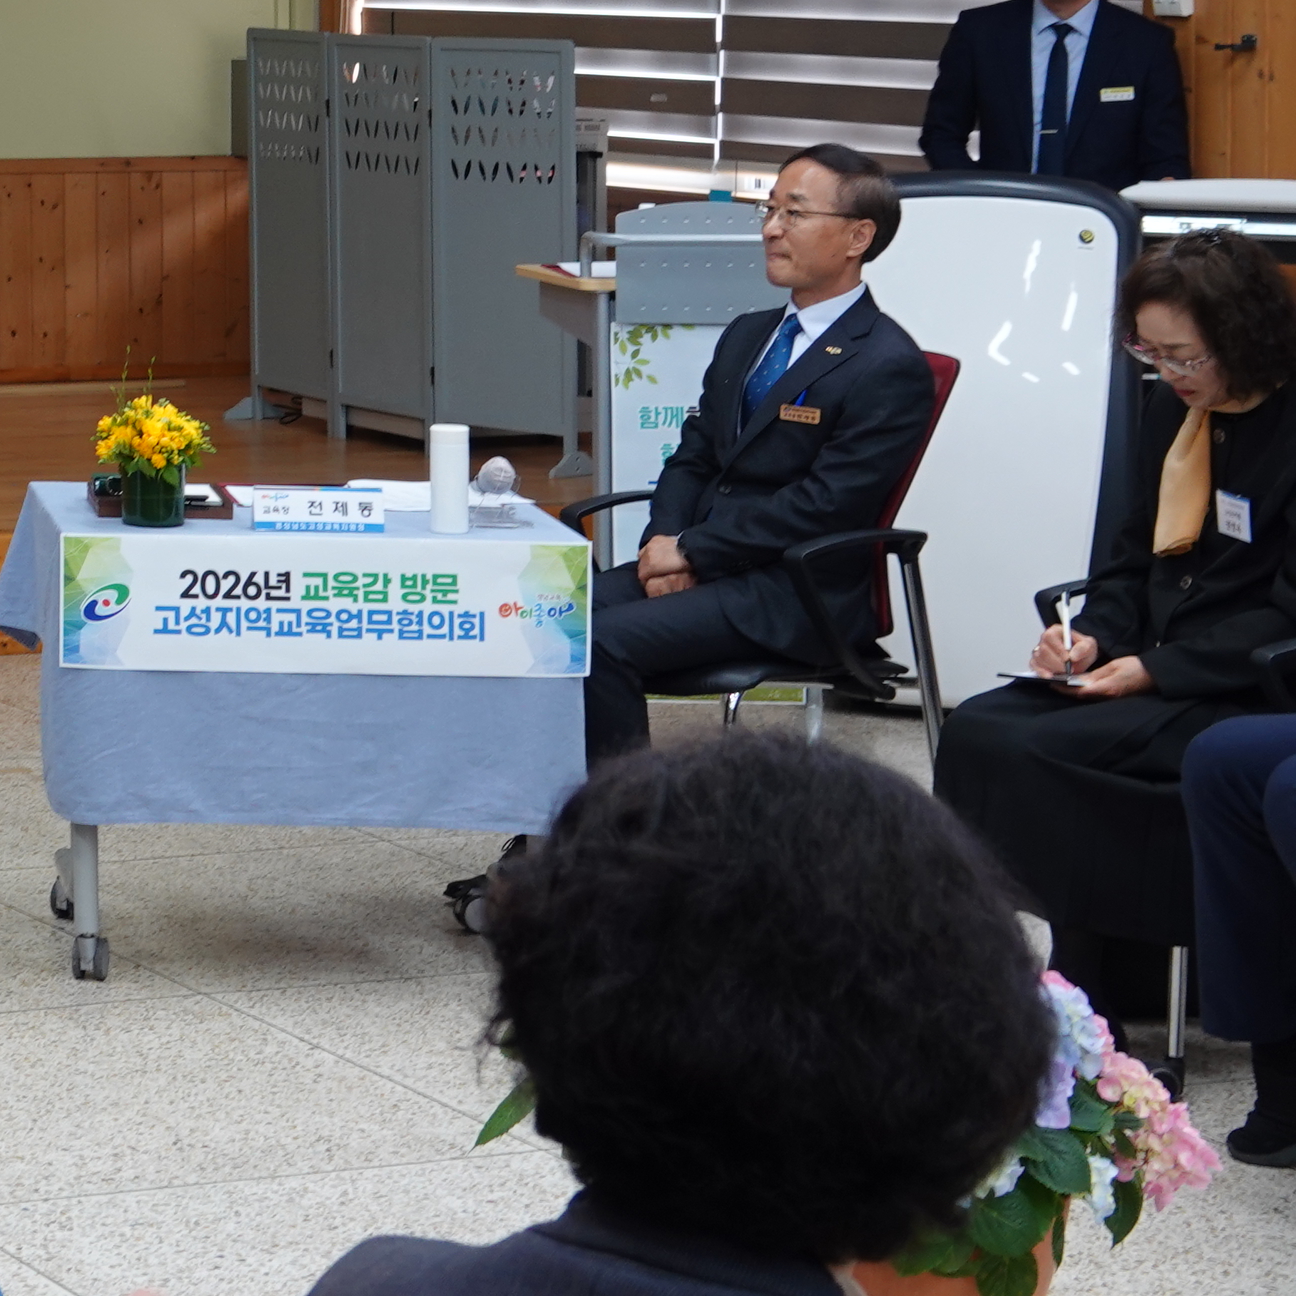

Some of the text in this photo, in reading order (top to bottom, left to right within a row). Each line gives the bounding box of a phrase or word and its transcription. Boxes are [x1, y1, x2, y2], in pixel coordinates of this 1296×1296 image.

[179, 569, 460, 604] 2026년 교육감 방문
[153, 605, 485, 642] 고성지역교육업무협의회
